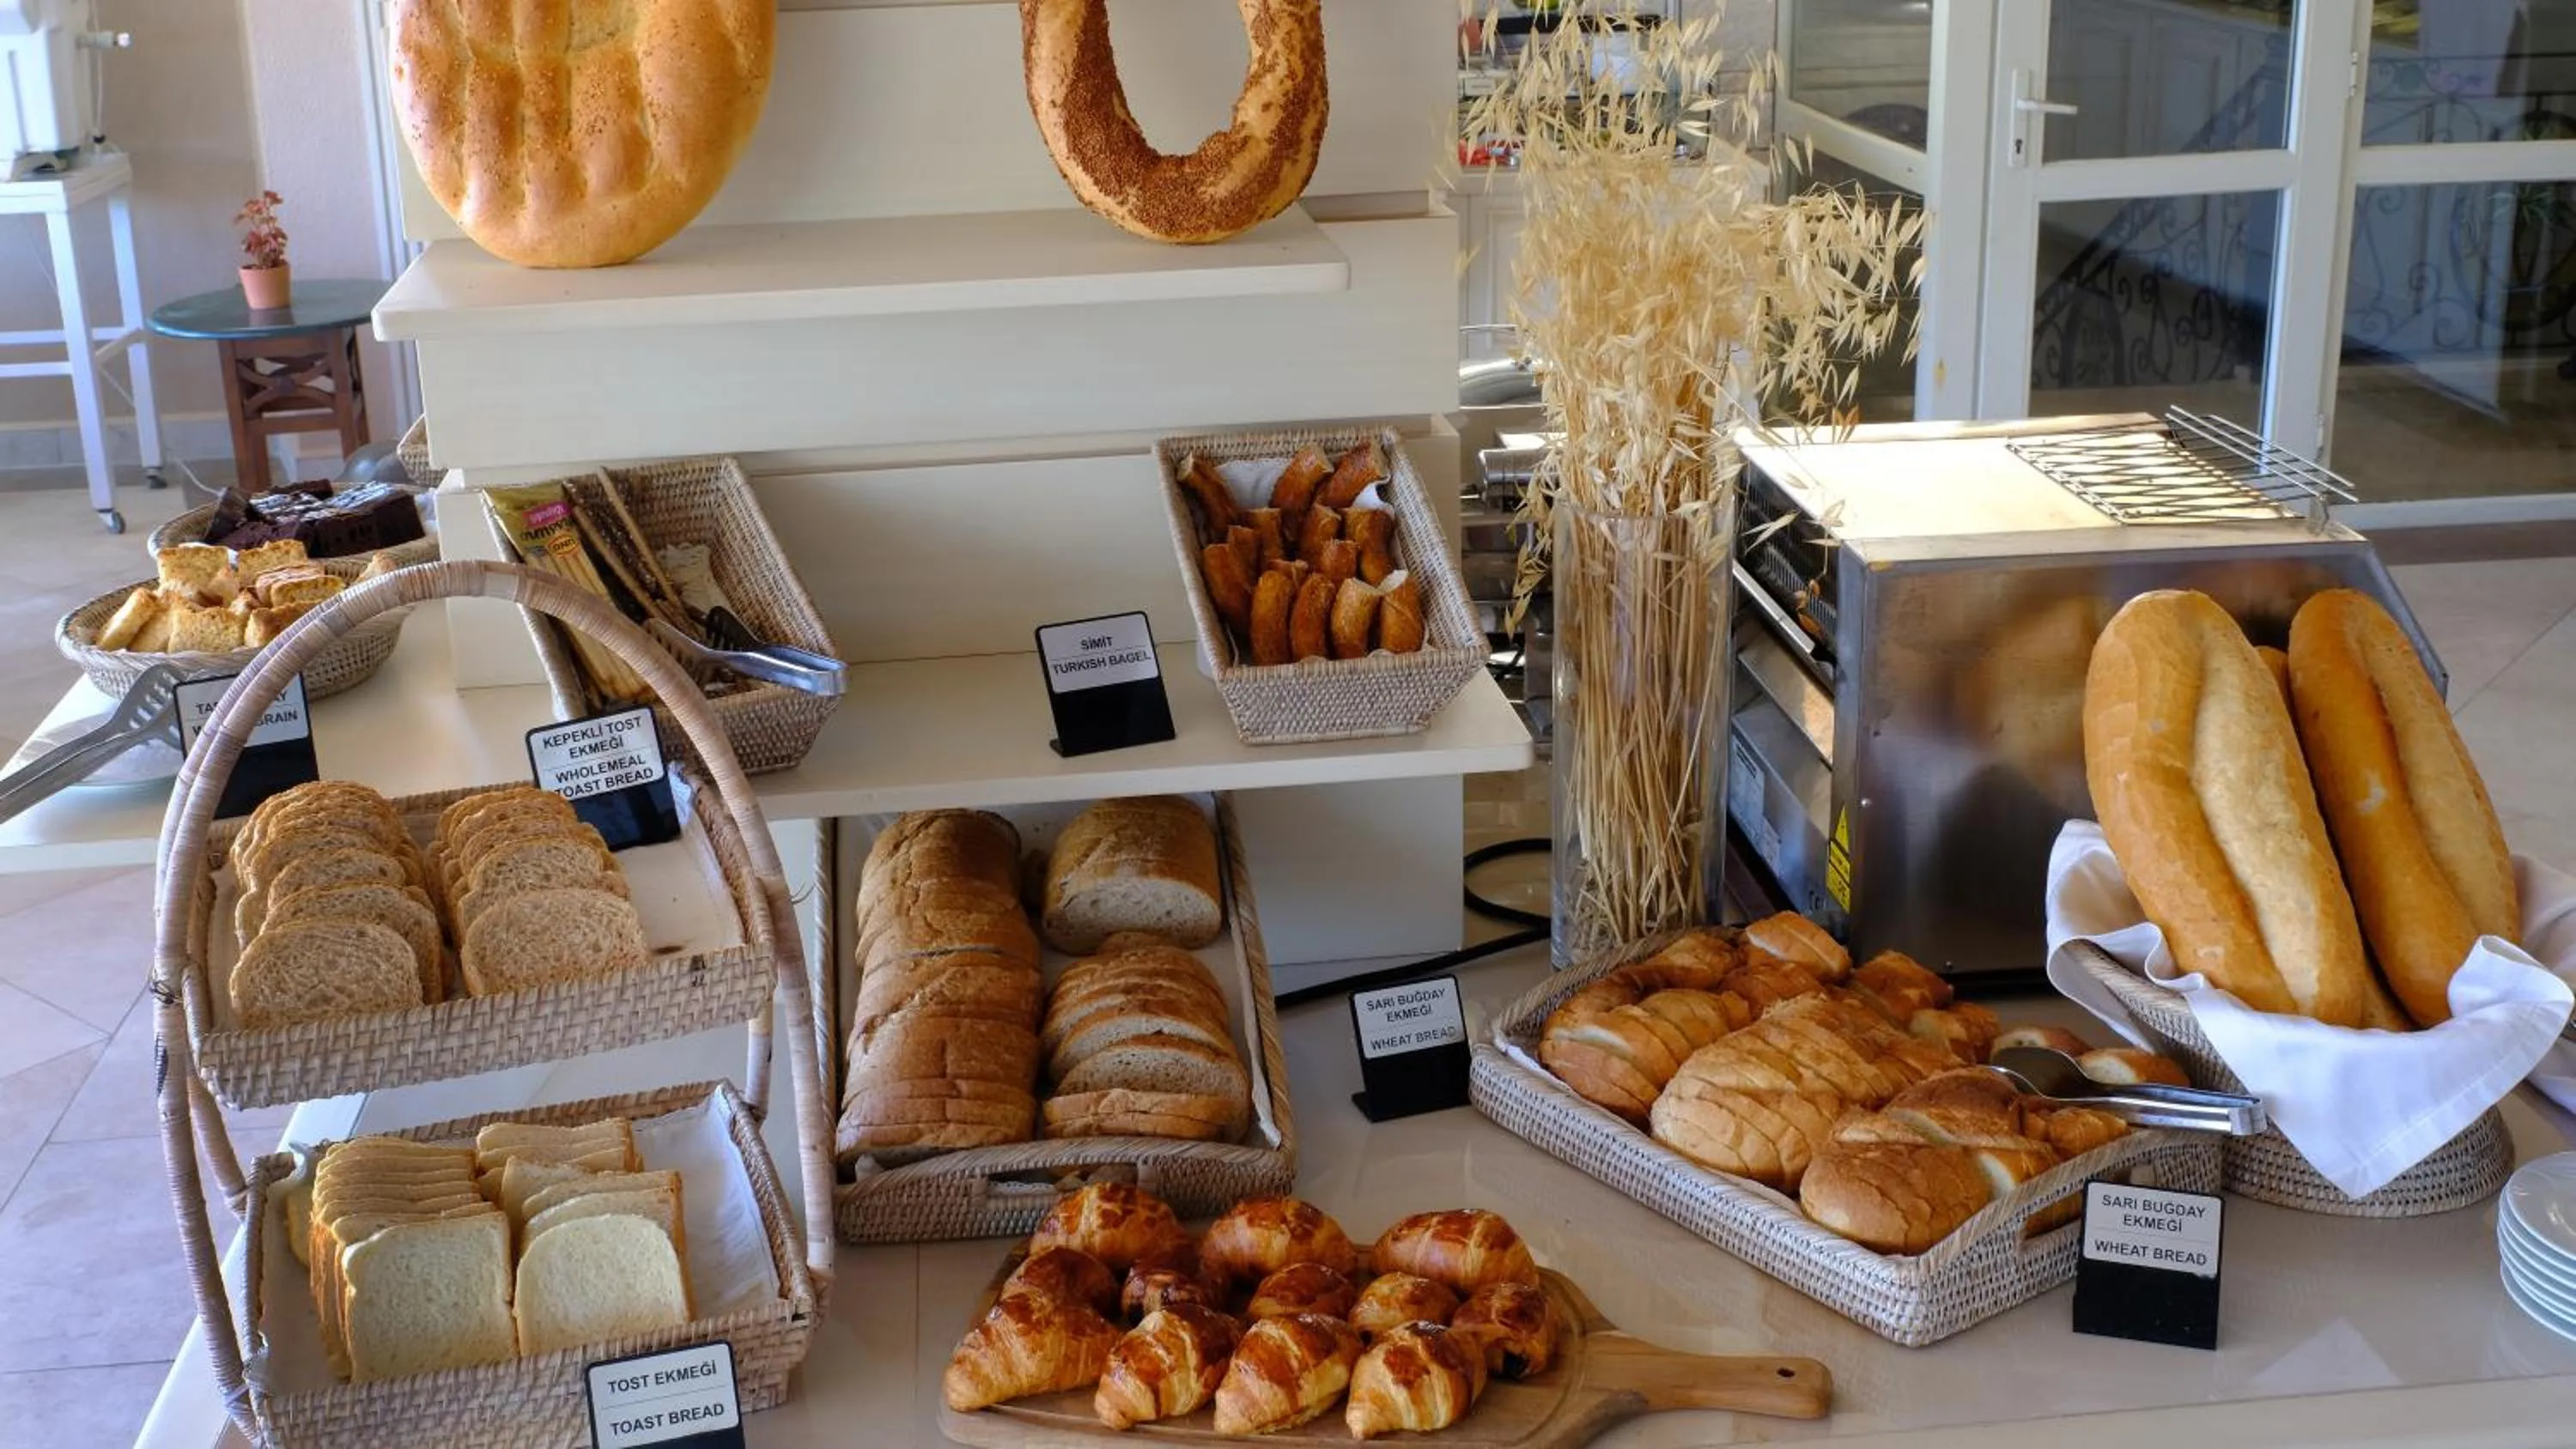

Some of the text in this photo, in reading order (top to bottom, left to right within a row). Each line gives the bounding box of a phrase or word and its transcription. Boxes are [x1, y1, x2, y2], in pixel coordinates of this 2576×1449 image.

[1052, 650, 1152, 674] TURKISH BAGEL
[196, 701, 218, 714] TA
[543, 716, 642, 749] KEPEKLİ TOST
[556, 755, 646, 783] WHOLEMEAL
[605, 767, 653, 788] BREAD
[1366, 997, 1396, 1011] SARI
[1370, 1026, 1457, 1051] WHEAT BREAD
[2101, 1194, 2137, 1210] SARI
[2094, 1239, 2208, 1266] WHEAT BREAD
[607, 1360, 717, 1393] TOST EKMEĞİ
[610, 1404, 725, 1436] TOAST BREAD
